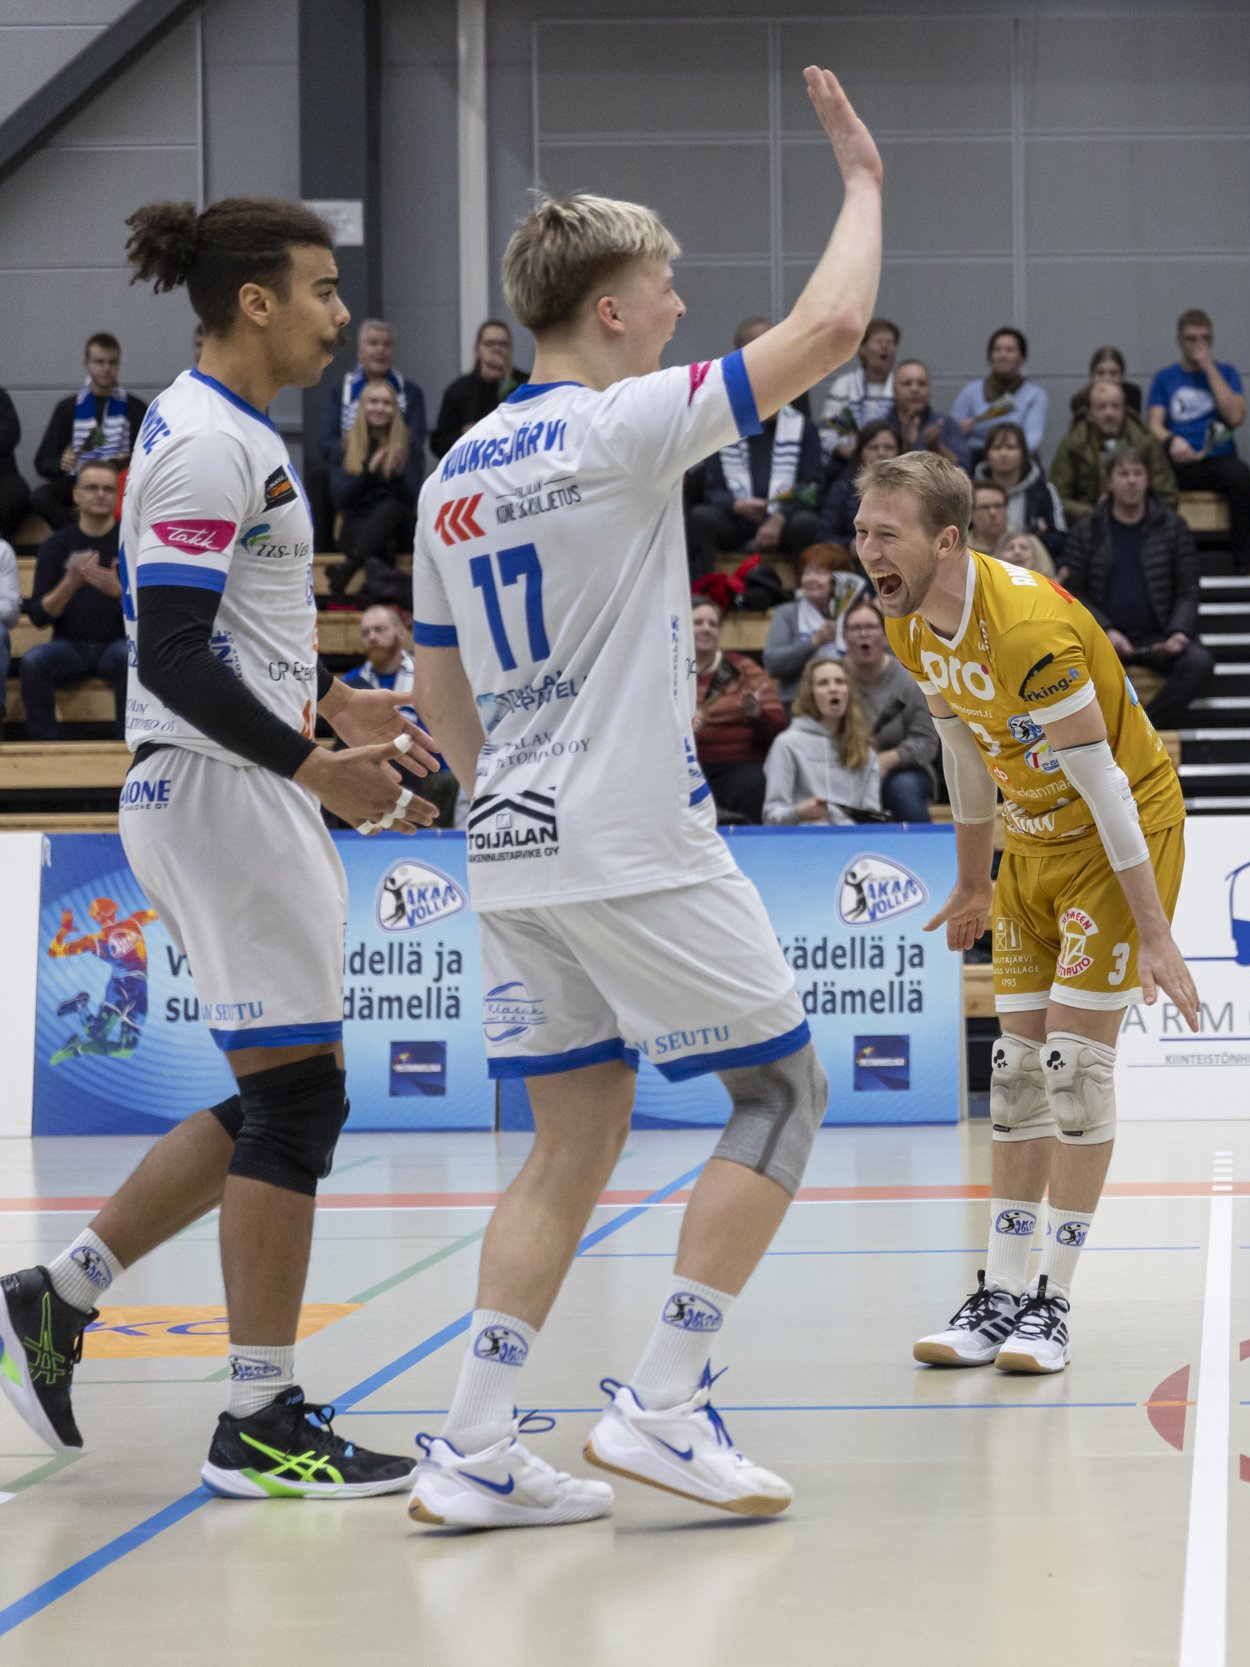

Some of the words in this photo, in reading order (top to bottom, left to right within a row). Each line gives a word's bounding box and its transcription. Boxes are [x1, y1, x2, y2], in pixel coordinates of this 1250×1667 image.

[469, 543, 550, 671] 17
[920, 649, 996, 701] pro
[468, 825, 559, 850] TOIJALAN
[433, 942, 463, 983] ja
[896, 938, 924, 977] ja
[1107, 942, 1131, 986] 3
[655, 1025, 731, 1056] SEUTU
